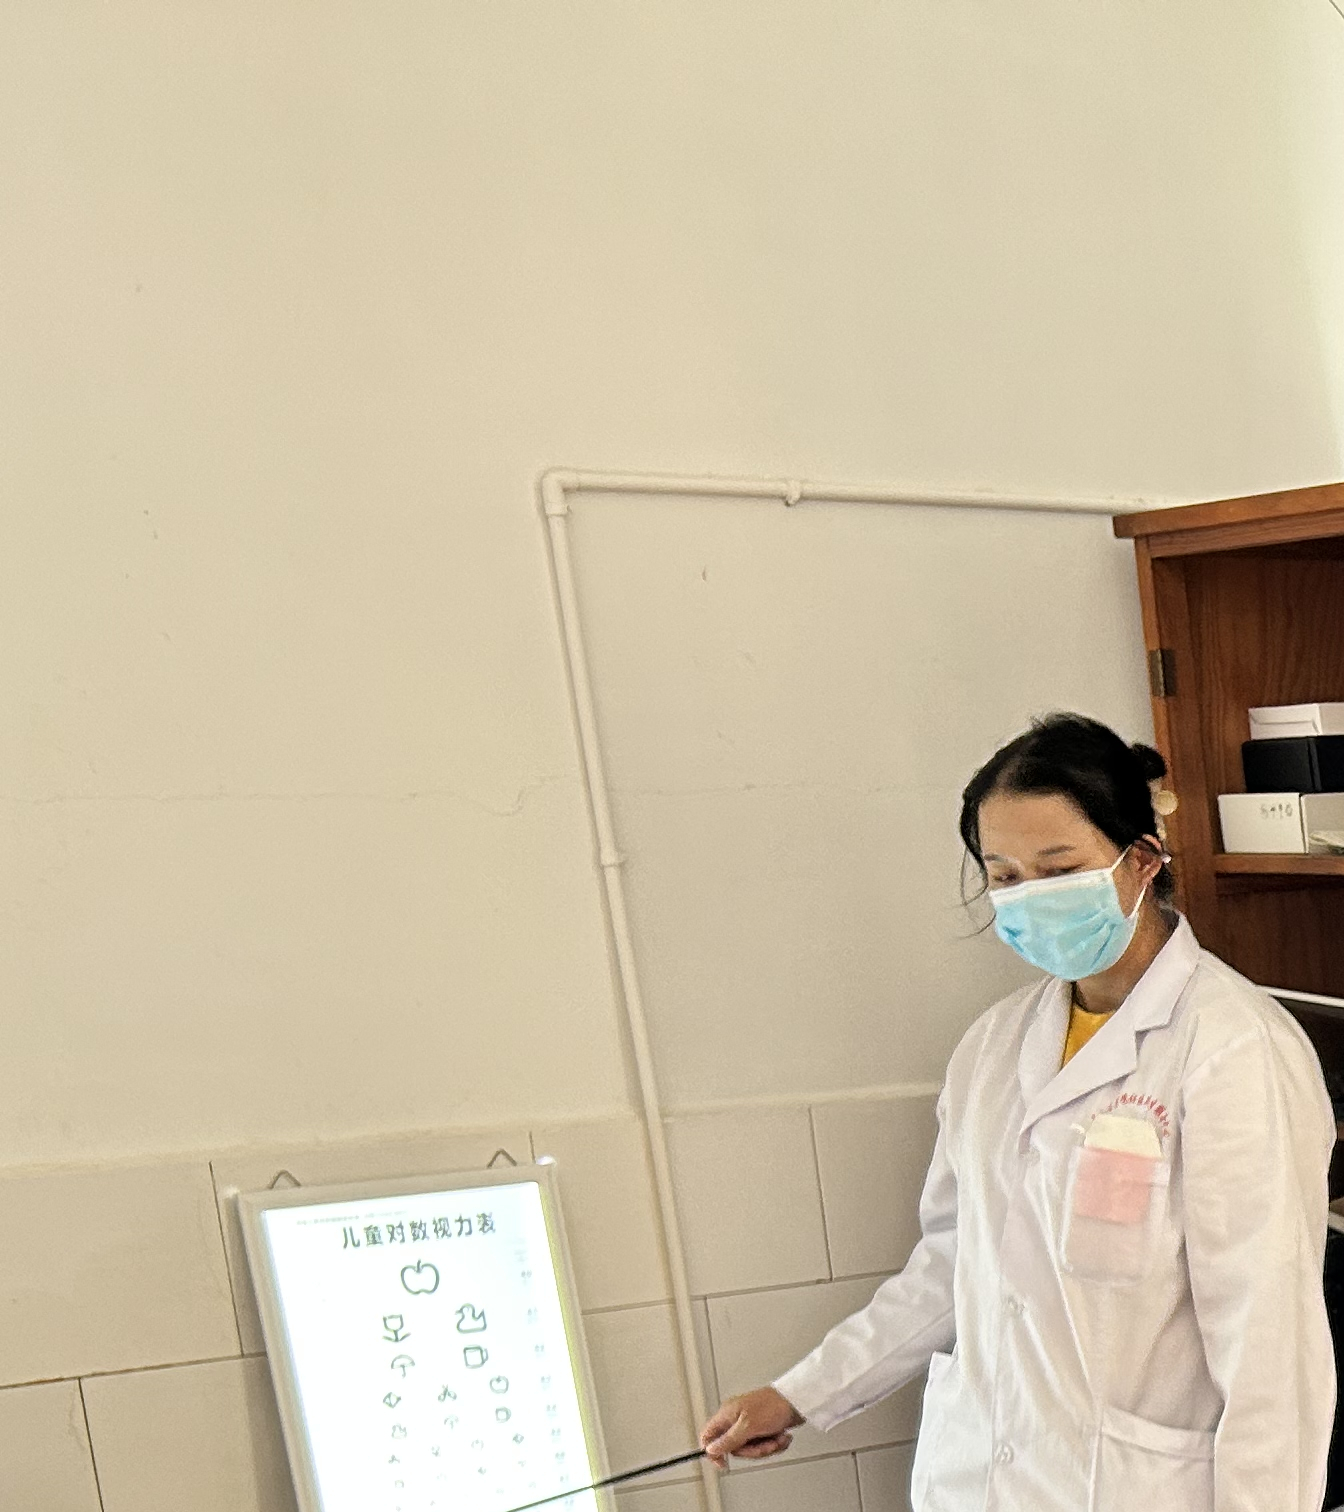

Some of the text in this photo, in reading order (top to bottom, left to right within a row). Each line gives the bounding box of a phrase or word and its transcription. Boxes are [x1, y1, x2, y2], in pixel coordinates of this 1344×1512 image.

[342, 1211, 496, 1250] 儿童对数视力表
